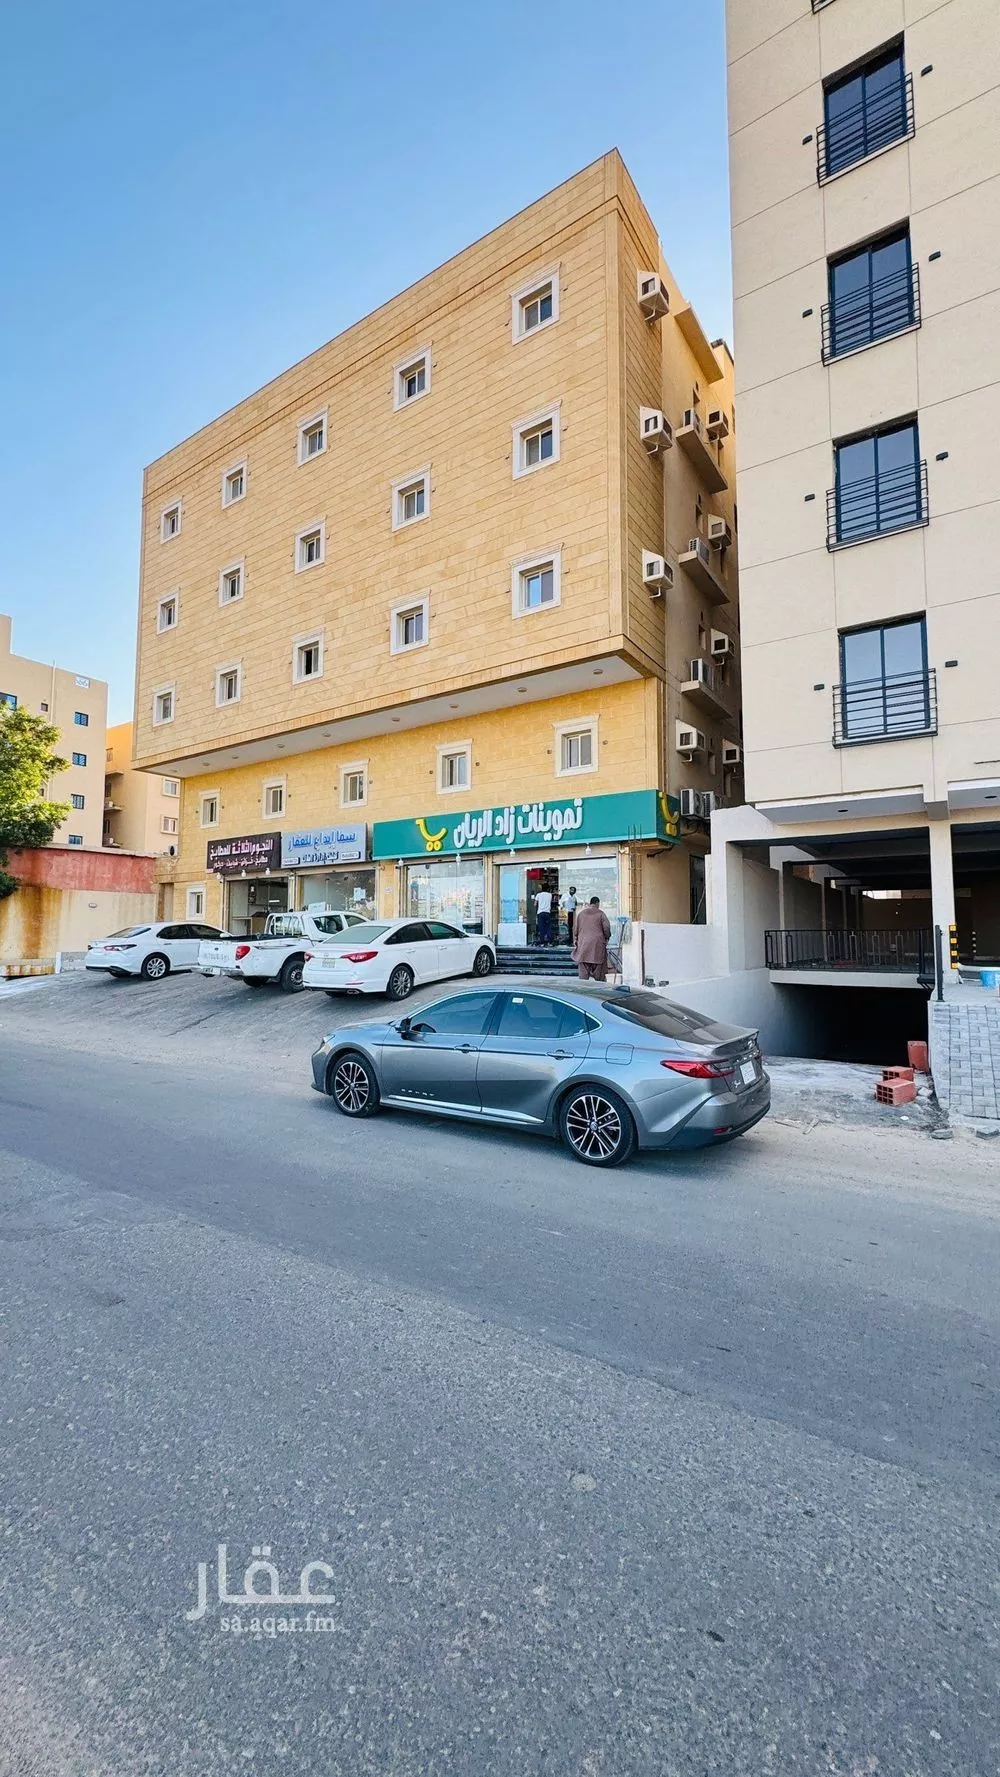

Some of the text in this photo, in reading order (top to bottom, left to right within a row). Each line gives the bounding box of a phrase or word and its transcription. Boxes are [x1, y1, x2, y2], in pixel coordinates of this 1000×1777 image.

[453, 798, 583, 848] تموينات زاد الريان
[210, 844, 232, 861] للمطابخ
[250, 838, 274, 855] النجوم
